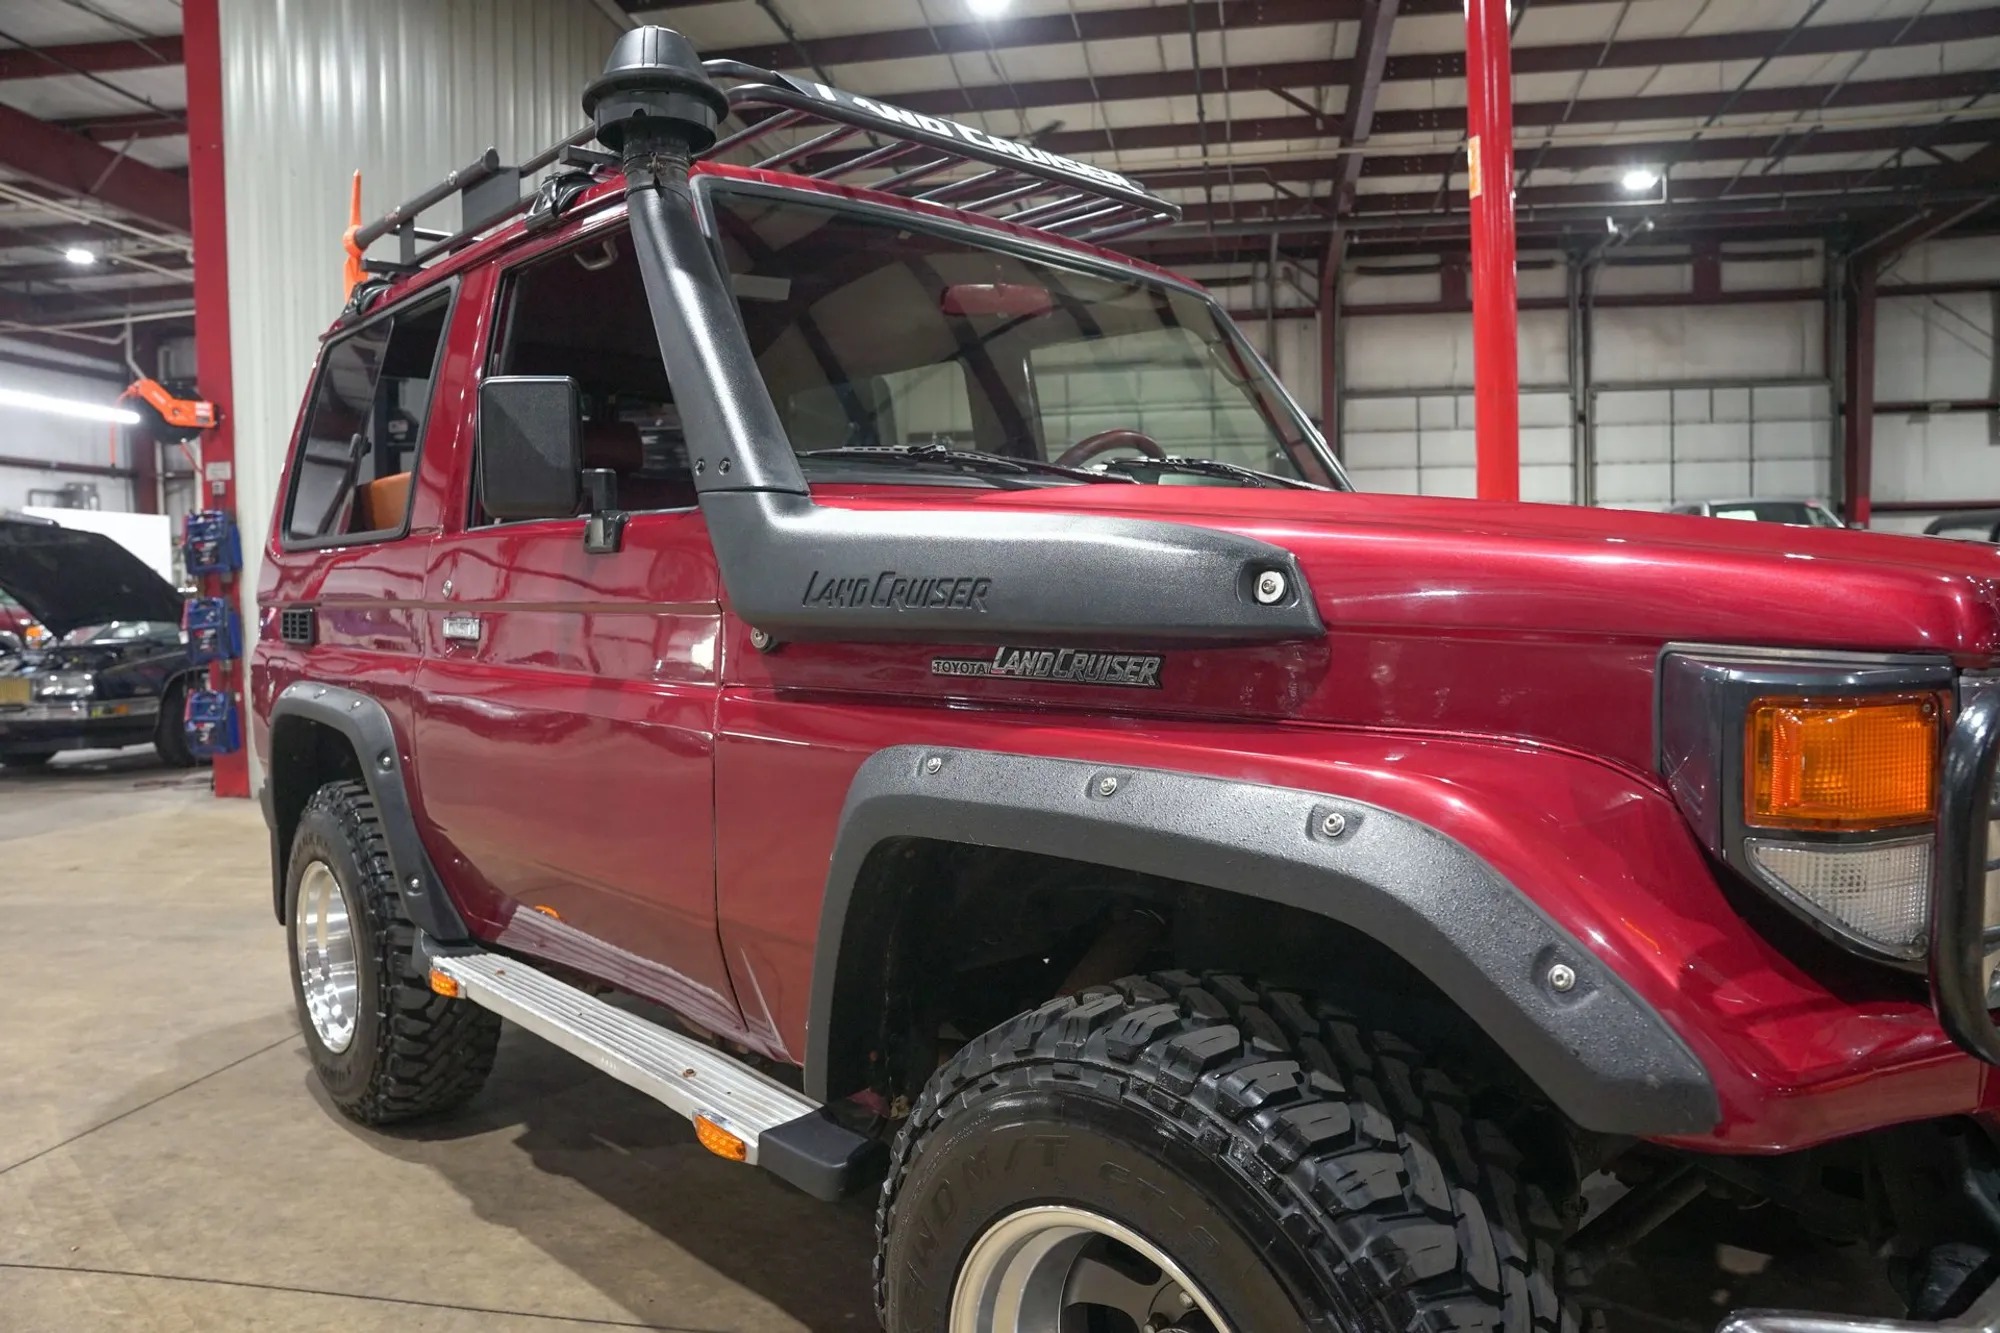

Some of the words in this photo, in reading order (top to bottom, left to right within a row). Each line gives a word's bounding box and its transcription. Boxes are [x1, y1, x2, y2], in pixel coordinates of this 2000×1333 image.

[938, 117, 1145, 194] CRUISER
[802, 571, 870, 609] LAND
[871, 571, 992, 613] CRUISER
[934, 660, 986, 675] TOYOTA
[989, 646, 1056, 678] LAND
[1052, 648, 1164, 687] CRUISER
